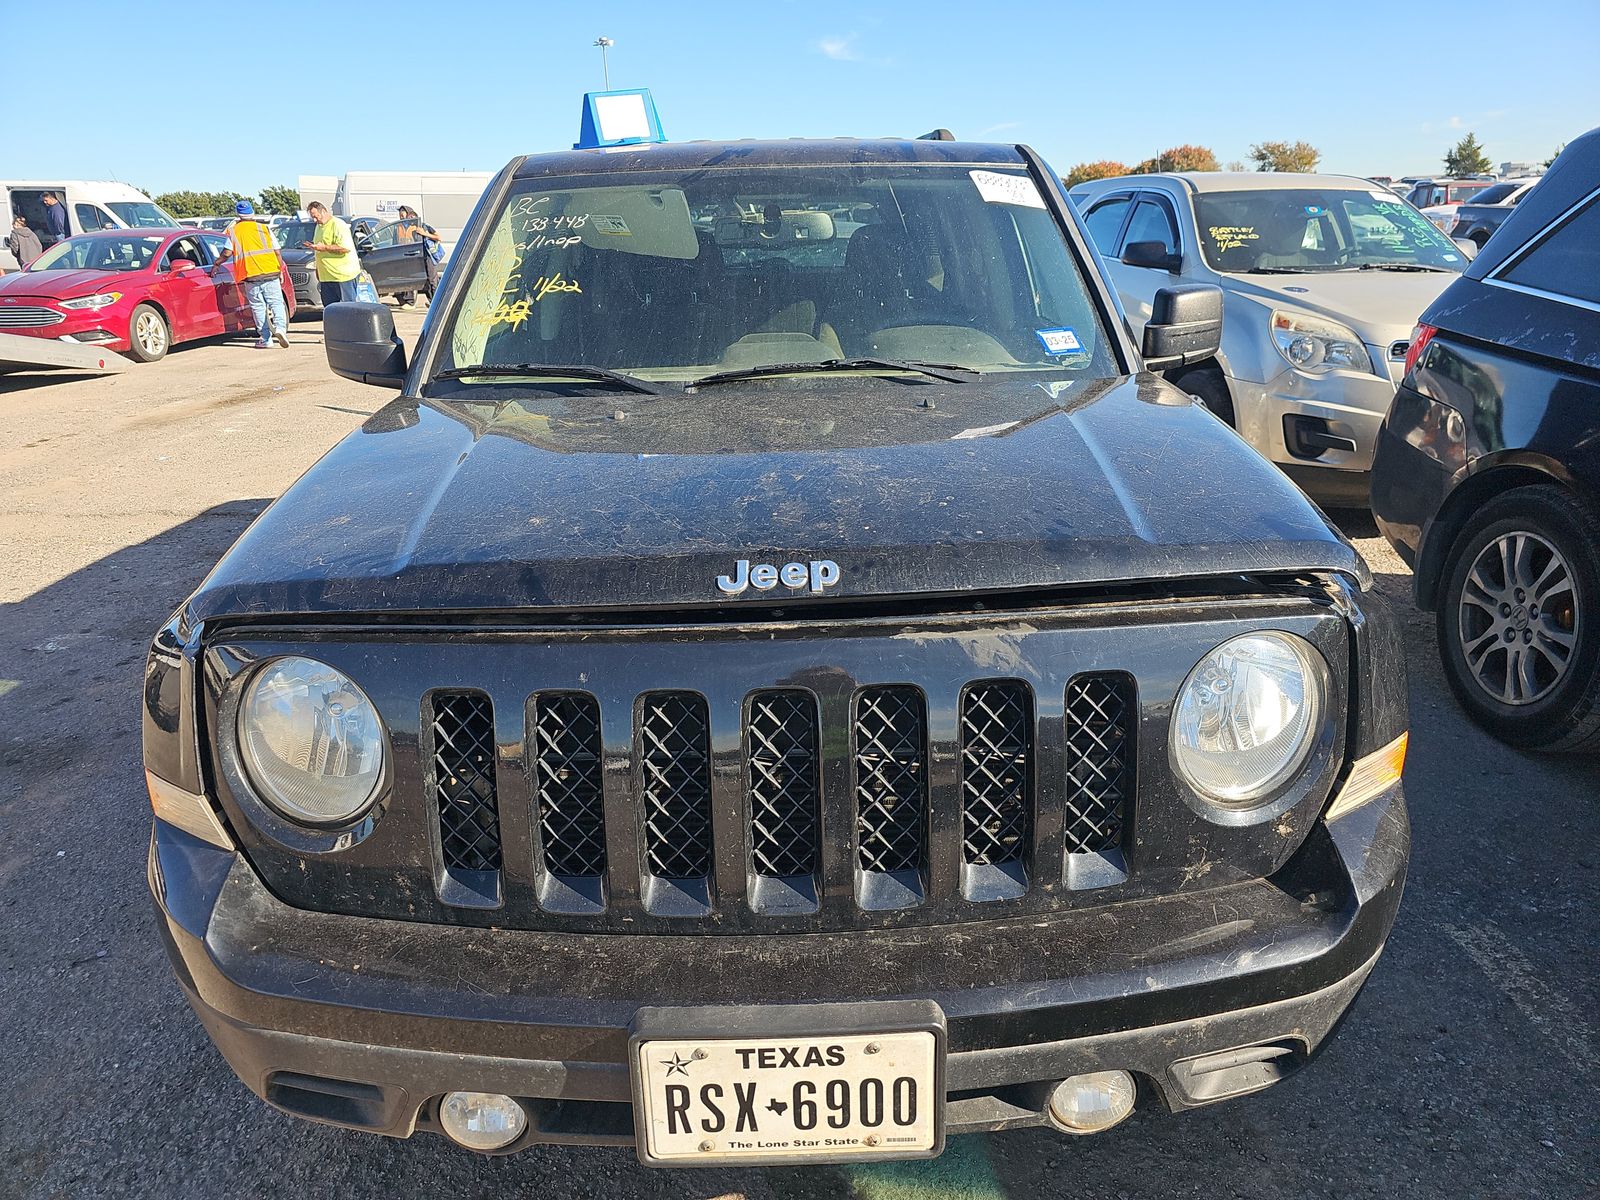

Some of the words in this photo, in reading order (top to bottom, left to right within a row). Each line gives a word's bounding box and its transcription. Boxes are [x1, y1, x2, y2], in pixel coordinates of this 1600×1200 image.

[715, 559, 840, 594] Jeep
[735, 1045, 845, 1070] TEXAS
[665, 1082, 759, 1135] RSX
[792, 1076, 918, 1131] 6900
[728, 1141, 753, 1149] The
[757, 1140, 789, 1148] Lone
[793, 1139, 820, 1147] Star
[824, 1137, 859, 1146] State
